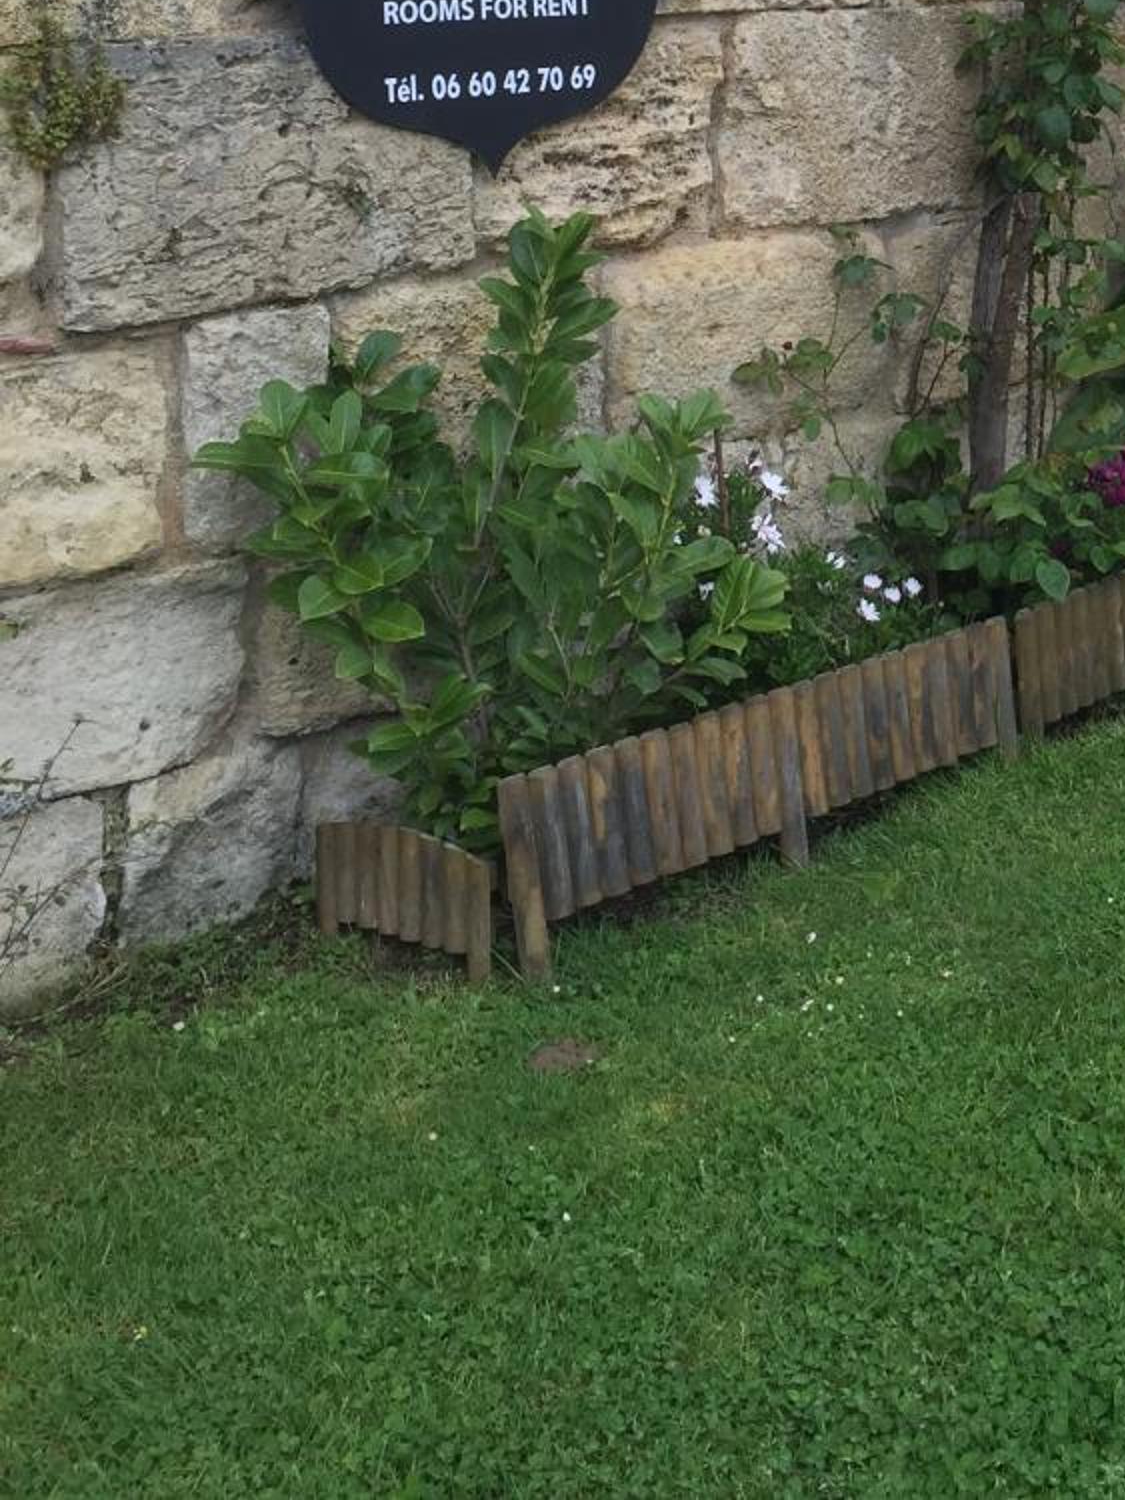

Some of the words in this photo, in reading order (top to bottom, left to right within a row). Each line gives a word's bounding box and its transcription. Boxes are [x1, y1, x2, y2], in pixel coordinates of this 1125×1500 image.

[384, 76, 425, 103] Tél.
[432, 74, 460, 100] 06
[468, 72, 497, 97] 60
[503, 69, 531, 95] 42
[537, 66, 563, 92] 70
[570, 62, 596, 89] 69
